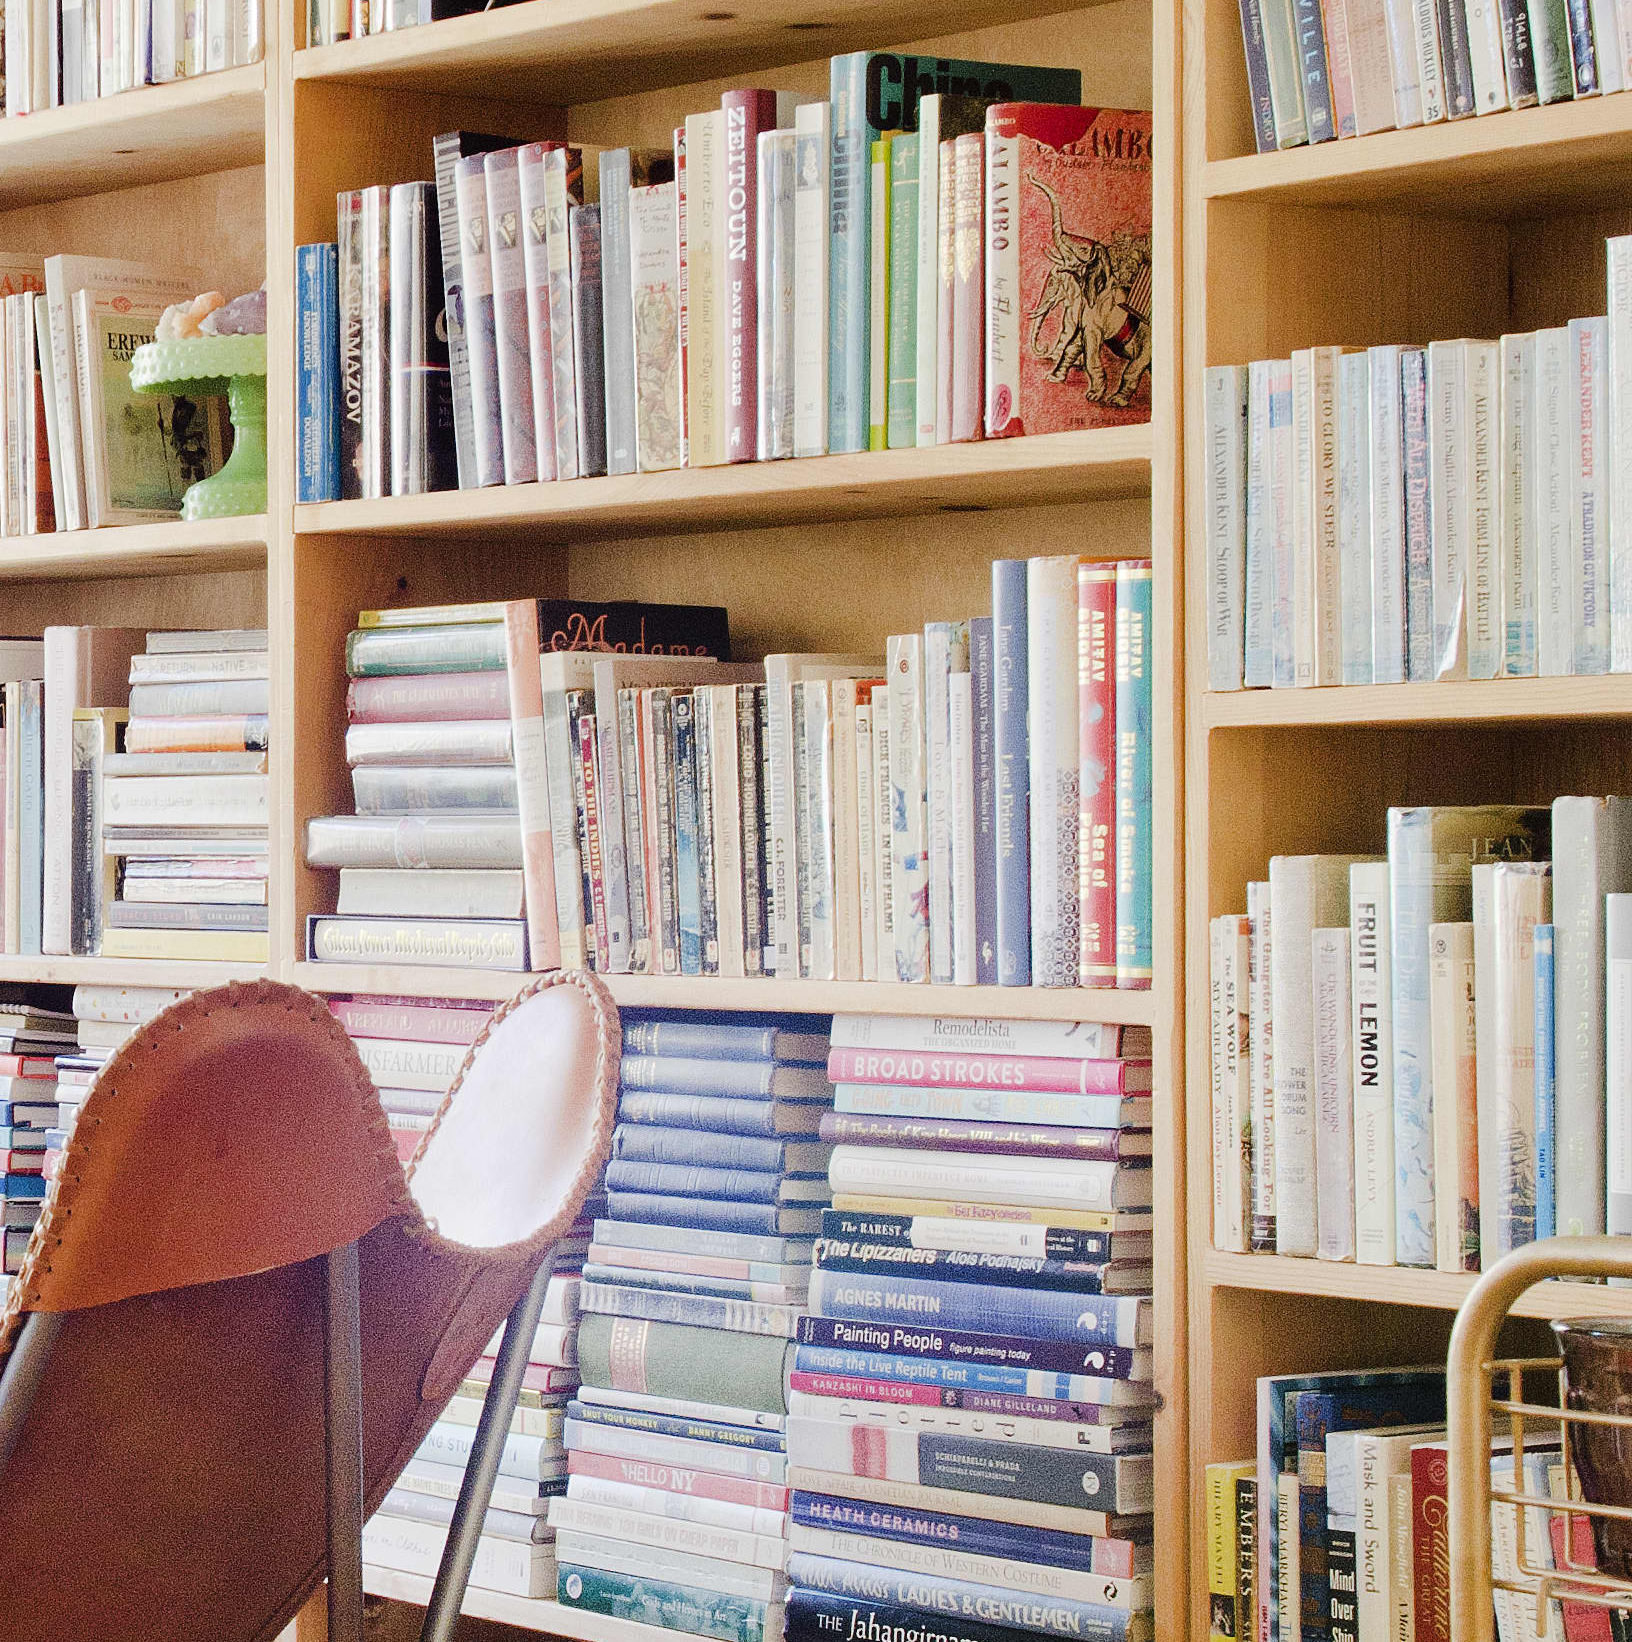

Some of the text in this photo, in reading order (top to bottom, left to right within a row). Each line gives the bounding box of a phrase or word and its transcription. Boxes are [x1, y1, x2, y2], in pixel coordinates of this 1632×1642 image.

[727, 105, 747, 261] ZEITOUN
[732, 280, 744, 335] DAVE
[1091, 610, 1105, 683] AMITAV
[1130, 612, 1143, 679] AMITAV
[1119, 732, 1137, 895] River of Smoke
[1468, 834, 1534, 861] JEAN
[1357, 903, 1377, 973] FRUIT
[933, 1018, 1011, 1039] Remodelista
[1359, 1002, 1379, 1087] LEMON
[853, 1056, 1026, 1086] BROAD STROKES
[823, 1238, 938, 1266] The Lipizzaners
[833, 1288, 942, 1314] AGNES MARTIN
[833, 1323, 944, 1352] Painting People
[809, 1352, 969, 1383] Inside the Live Reptile Tent
[973, 1395, 1058, 1414] DIANE GILLELAND
[687, 1426, 755, 1445] DANNY GREGORY
[628, 1463, 697, 1492] HELLO NY
[809, 1502, 960, 1541] HEATH CERAMICS
[1363, 1443, 1380, 1594] Mask and Sword
[1238, 1491, 1254, 1596] EMBERS
[831, 1534, 1062, 1589] THE CHRONICLE OF WESTERN COSTUME
[1422, 1494, 1450, 1640] Catherine
[1328, 1567, 1356, 1593] Mind
[817, 1613, 844, 1633] THE
[1329, 1597, 1355, 1621] Over
